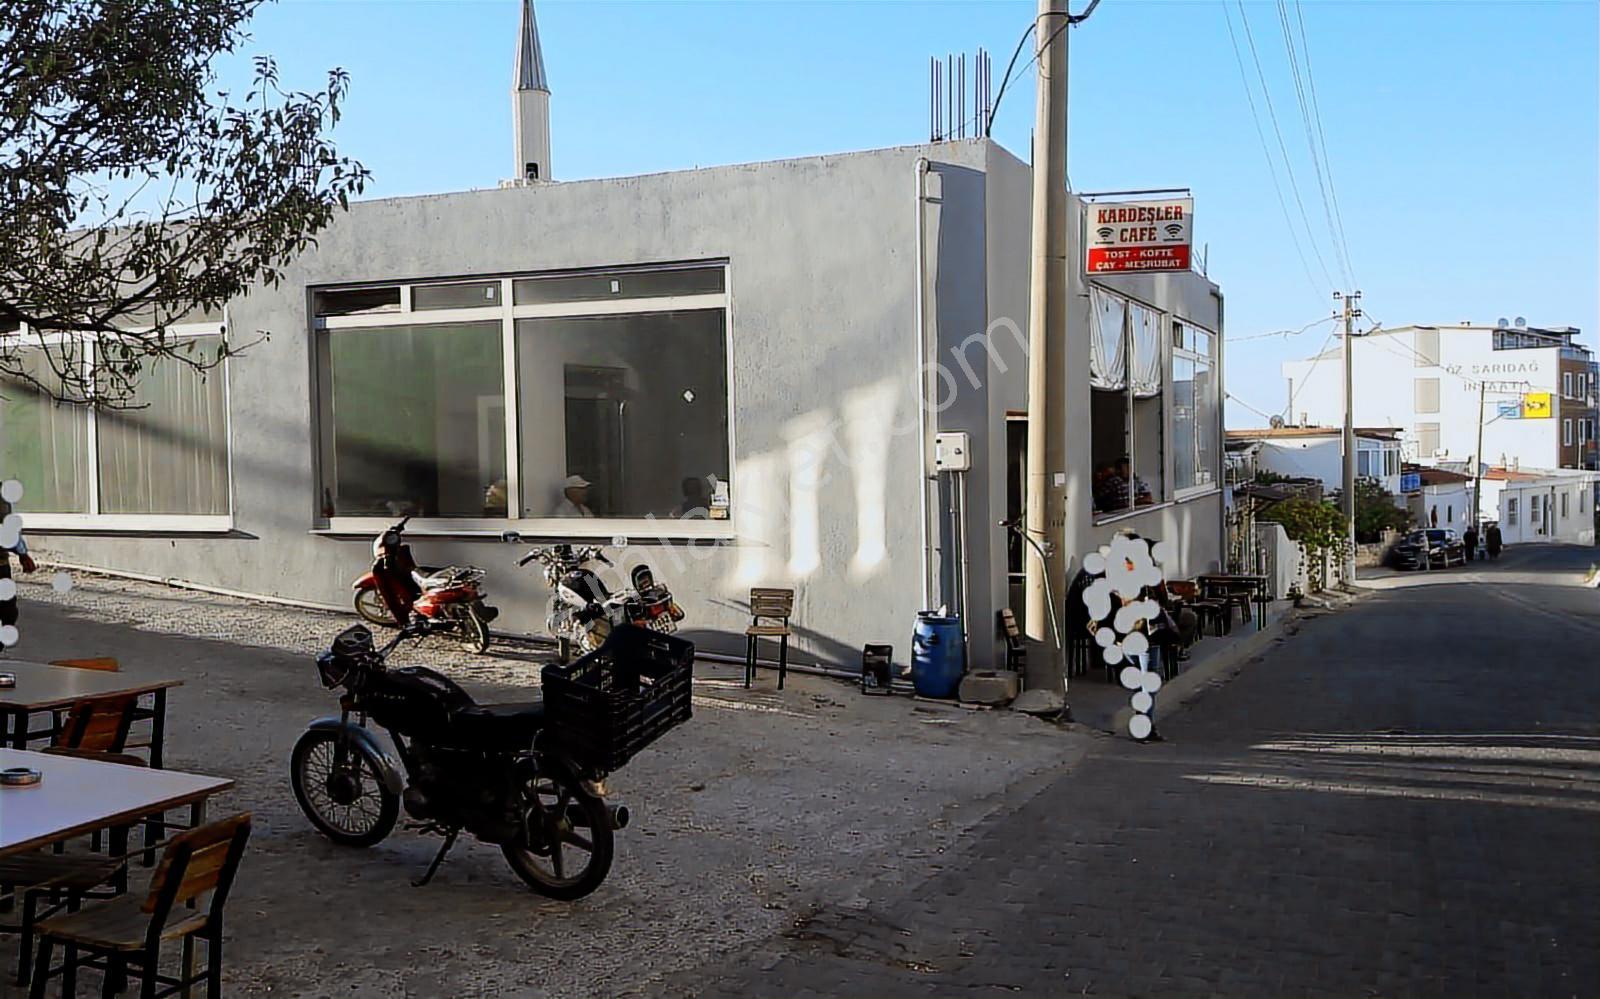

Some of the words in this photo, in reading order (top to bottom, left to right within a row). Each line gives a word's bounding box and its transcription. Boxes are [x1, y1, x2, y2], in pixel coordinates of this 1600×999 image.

[1098, 206, 1183, 225] KARDEŞLER
[1120, 227, 1157, 242] CAFE
[1104, 250, 1131, 259] TOST
[1096, 261, 1116, 271] ÇAY
[1464, 380, 1518, 393] İNAAT
